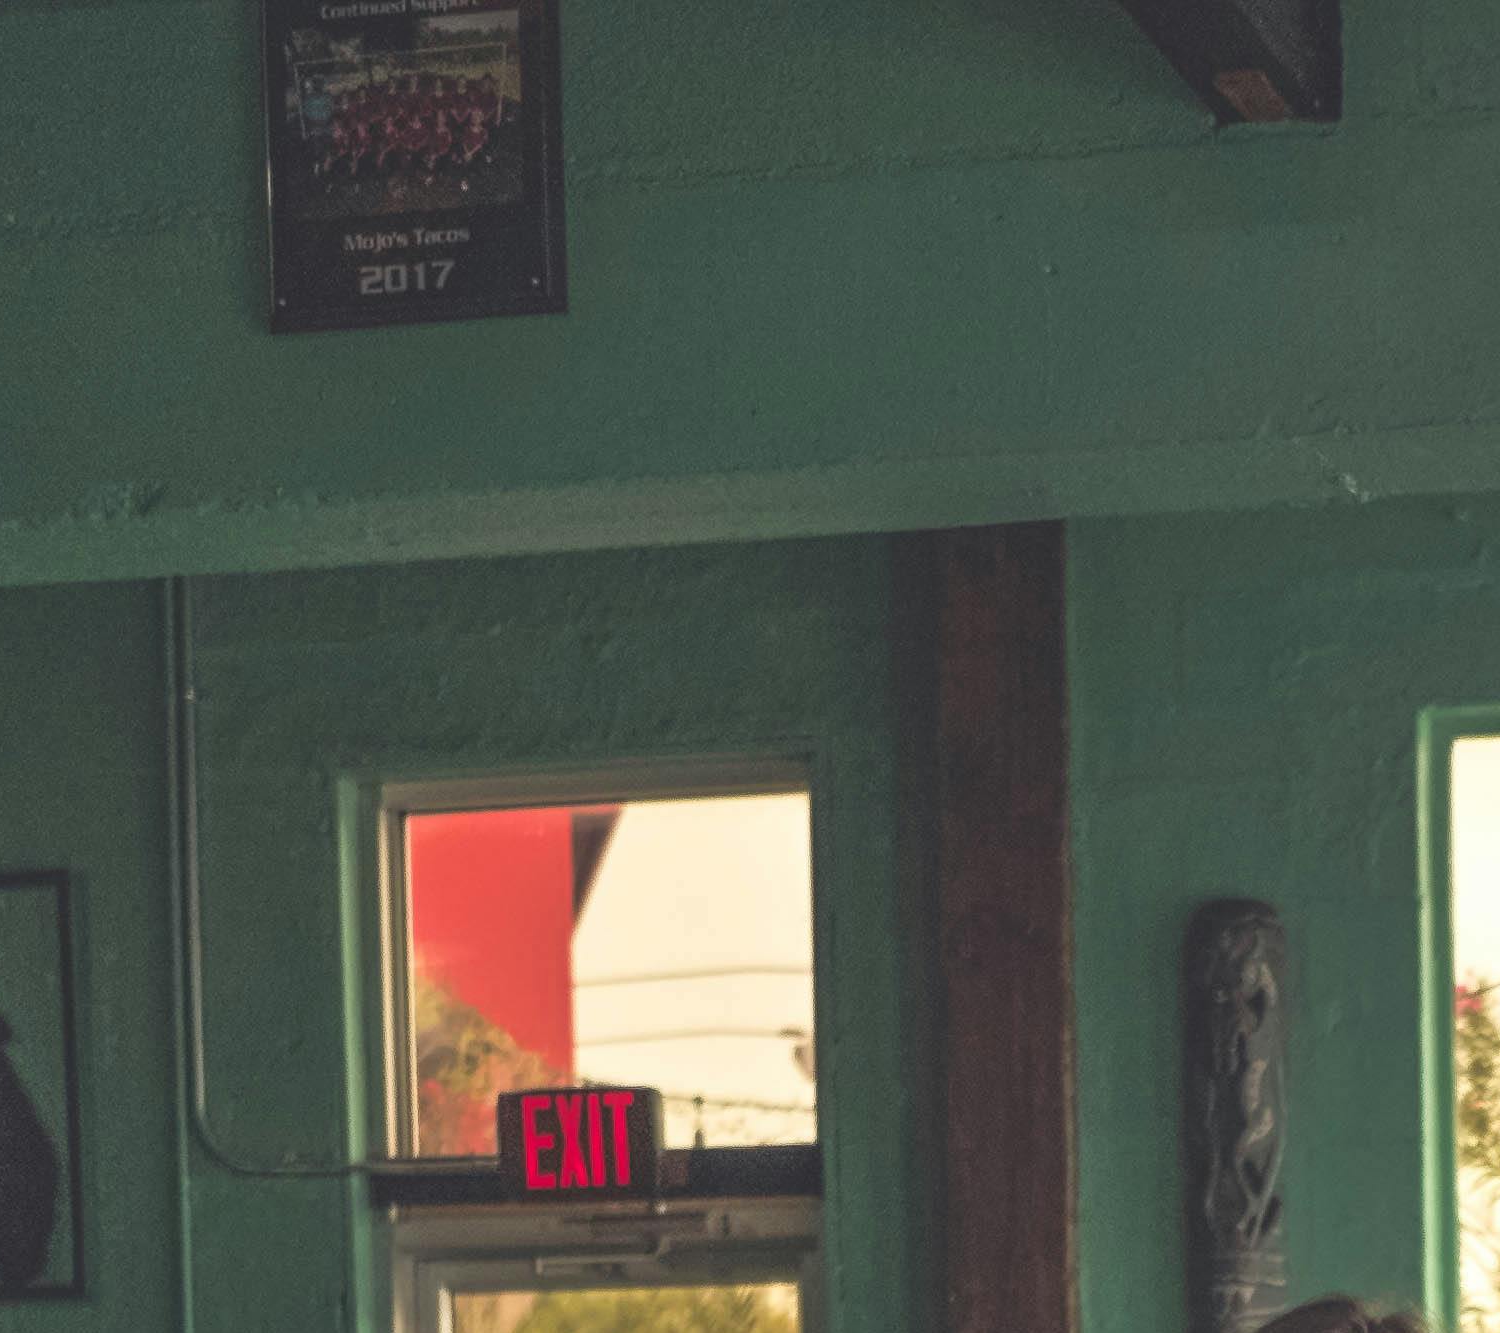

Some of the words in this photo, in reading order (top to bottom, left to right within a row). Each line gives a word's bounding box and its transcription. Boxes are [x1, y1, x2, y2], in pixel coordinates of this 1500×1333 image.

[413, 227, 470, 247] Tacos
[359, 261, 455, 296] 2017
[521, 1091, 634, 1190] EXIT
